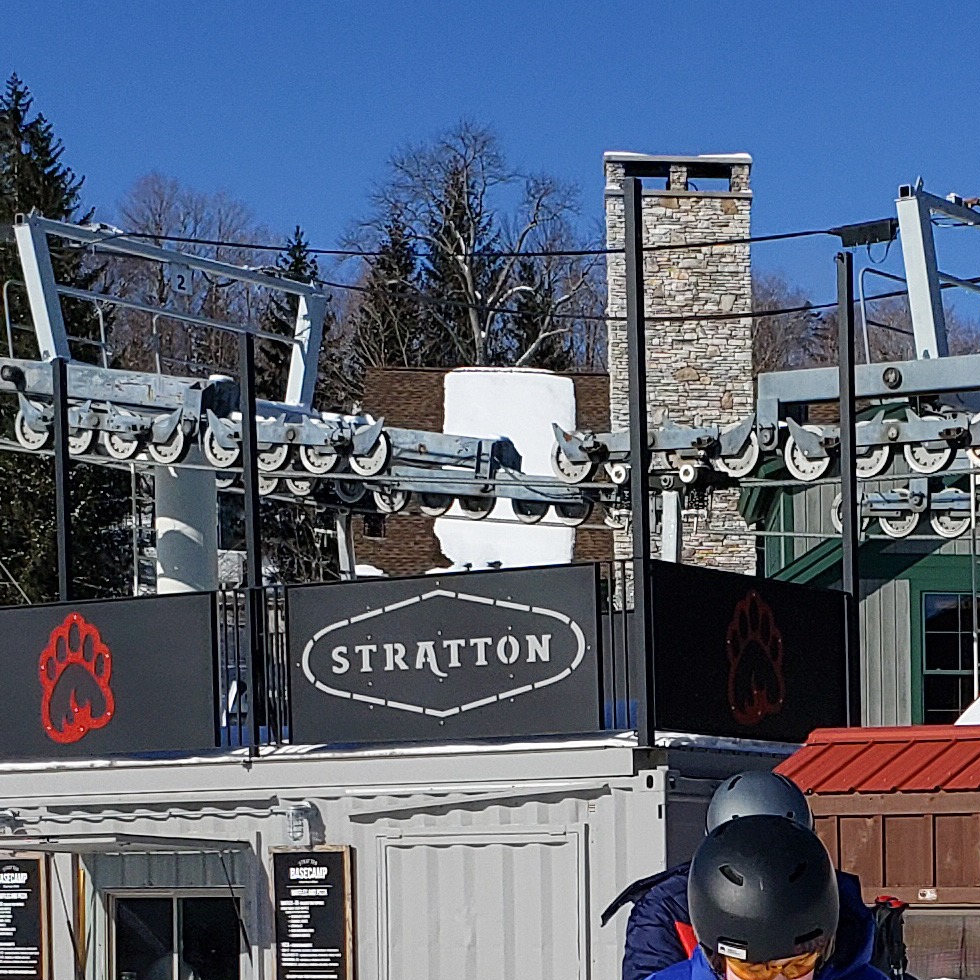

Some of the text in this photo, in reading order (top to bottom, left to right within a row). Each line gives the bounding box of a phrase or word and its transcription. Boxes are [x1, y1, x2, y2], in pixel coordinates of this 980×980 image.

[177, 274, 186, 290] 2
[331, 634, 552, 678] STRATTON
[289, 867, 328, 879] BASECAMP
